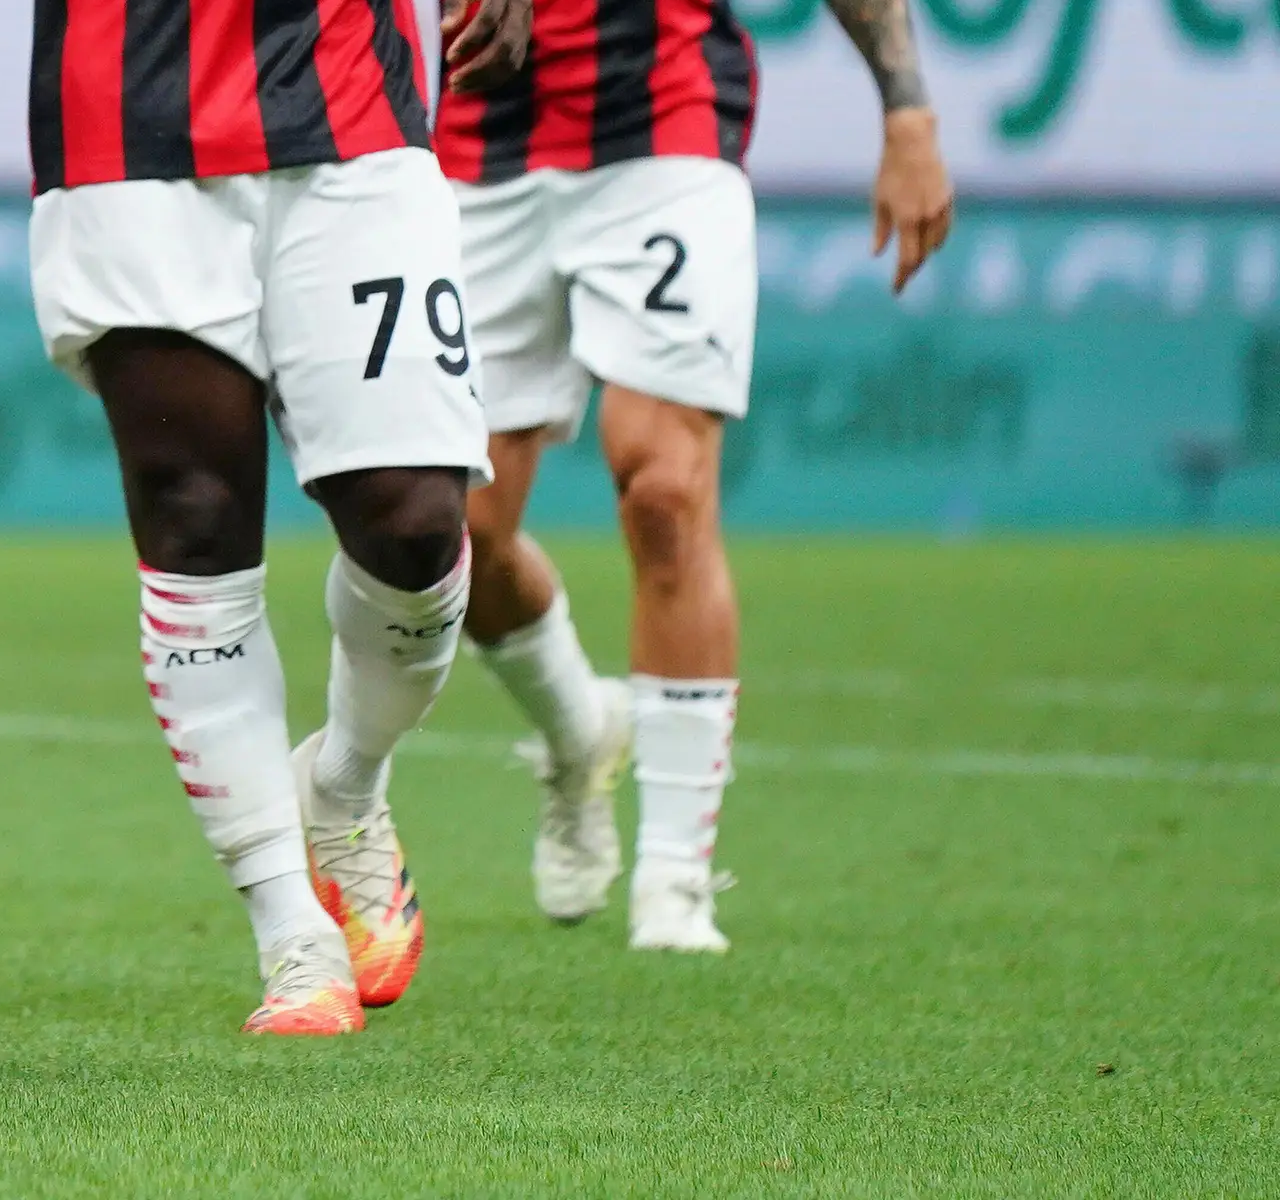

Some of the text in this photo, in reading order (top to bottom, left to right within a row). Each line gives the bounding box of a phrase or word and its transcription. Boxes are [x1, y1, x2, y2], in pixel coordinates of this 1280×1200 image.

[644, 233, 688, 313] 2
[352, 276, 468, 380] 79
[166, 643, 246, 669] ACM
